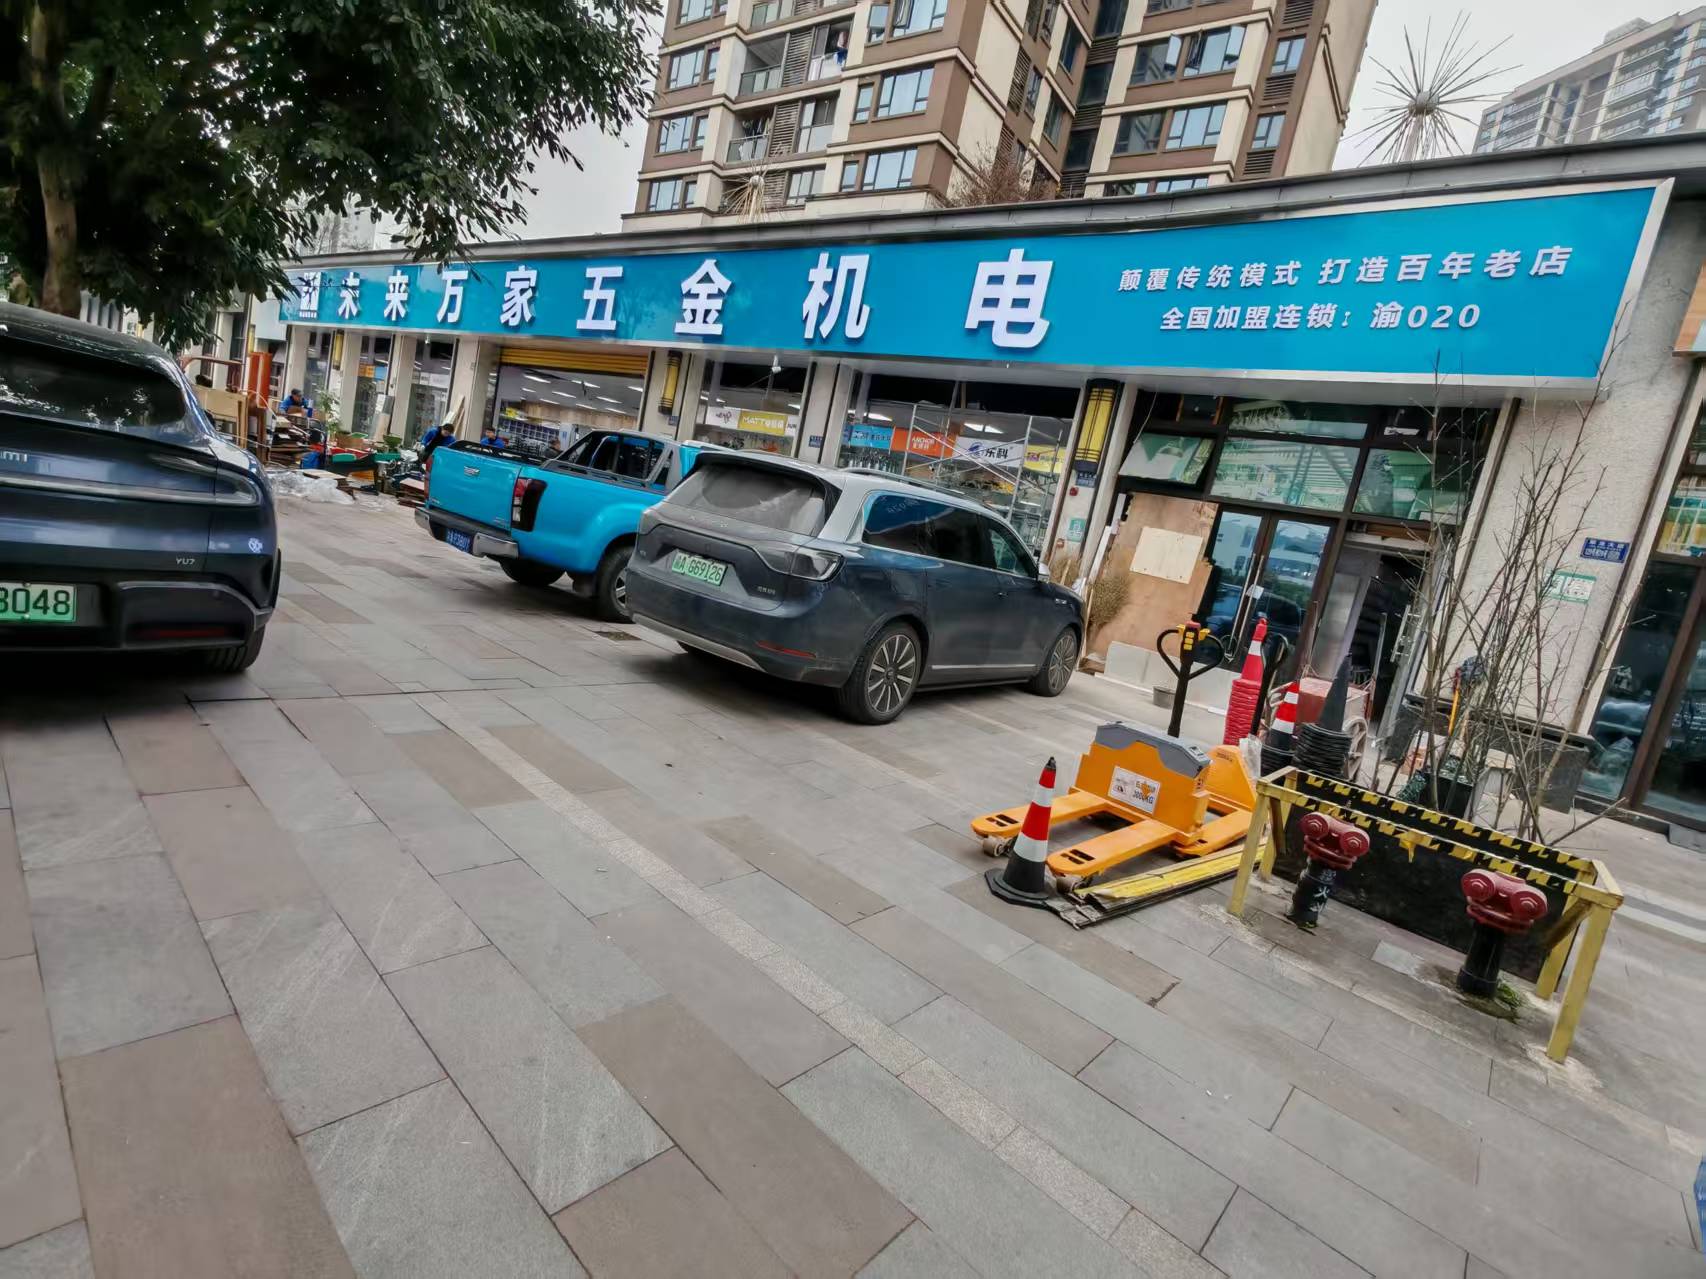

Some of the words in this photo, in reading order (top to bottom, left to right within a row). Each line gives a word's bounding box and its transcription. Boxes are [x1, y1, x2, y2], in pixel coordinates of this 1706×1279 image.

[1118, 259, 1303, 293] 颠覆传统模式
[1318, 245, 1573, 285] 打造百年老店
